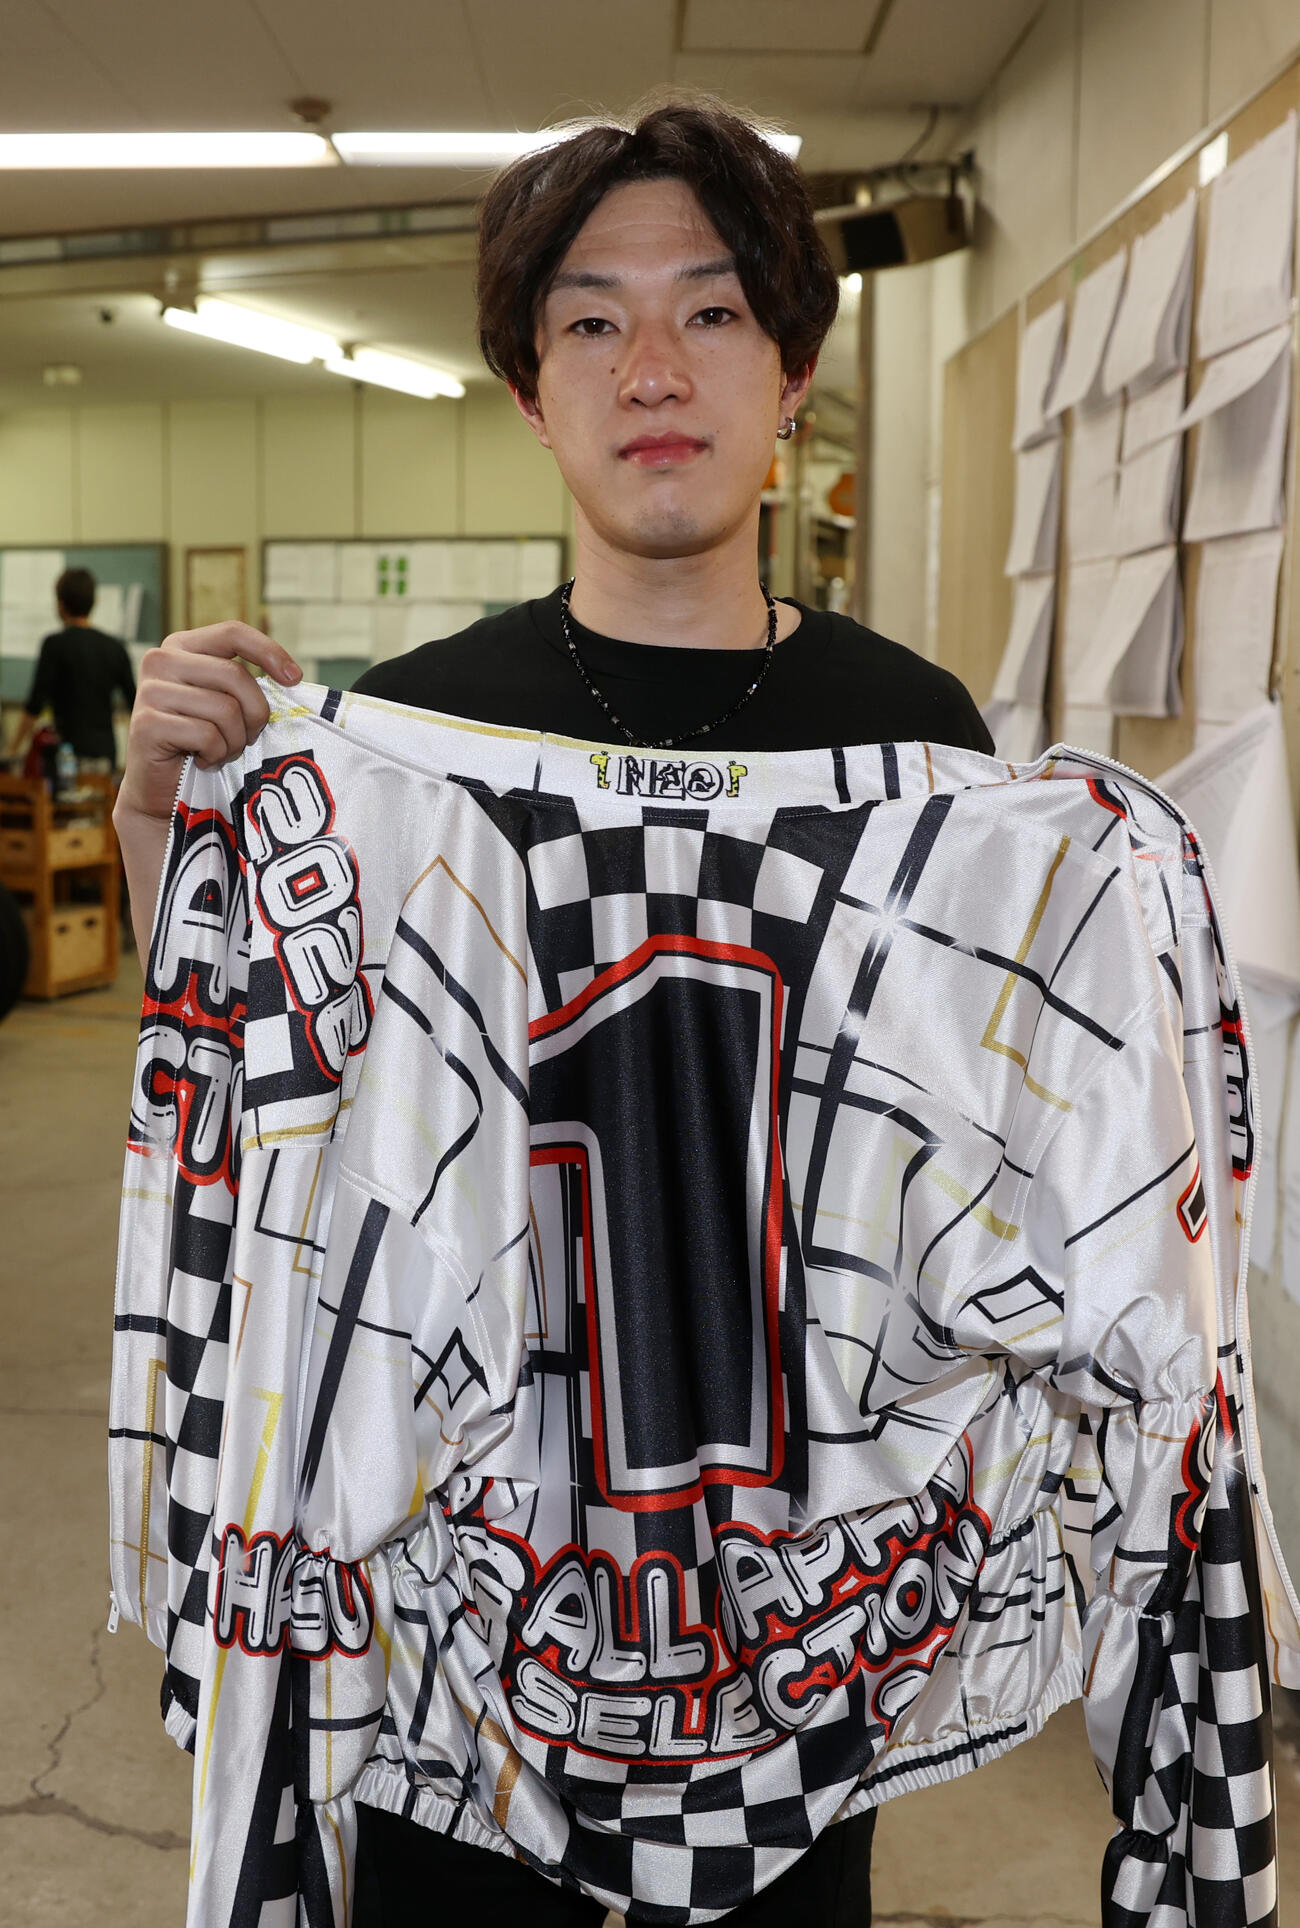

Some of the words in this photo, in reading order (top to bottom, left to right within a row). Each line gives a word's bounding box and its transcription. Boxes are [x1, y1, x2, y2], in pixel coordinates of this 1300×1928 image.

[616, 755, 723, 802] NEO
[511, 1517, 984, 1757] SELECTION
[521, 1559, 708, 1683] ALL
